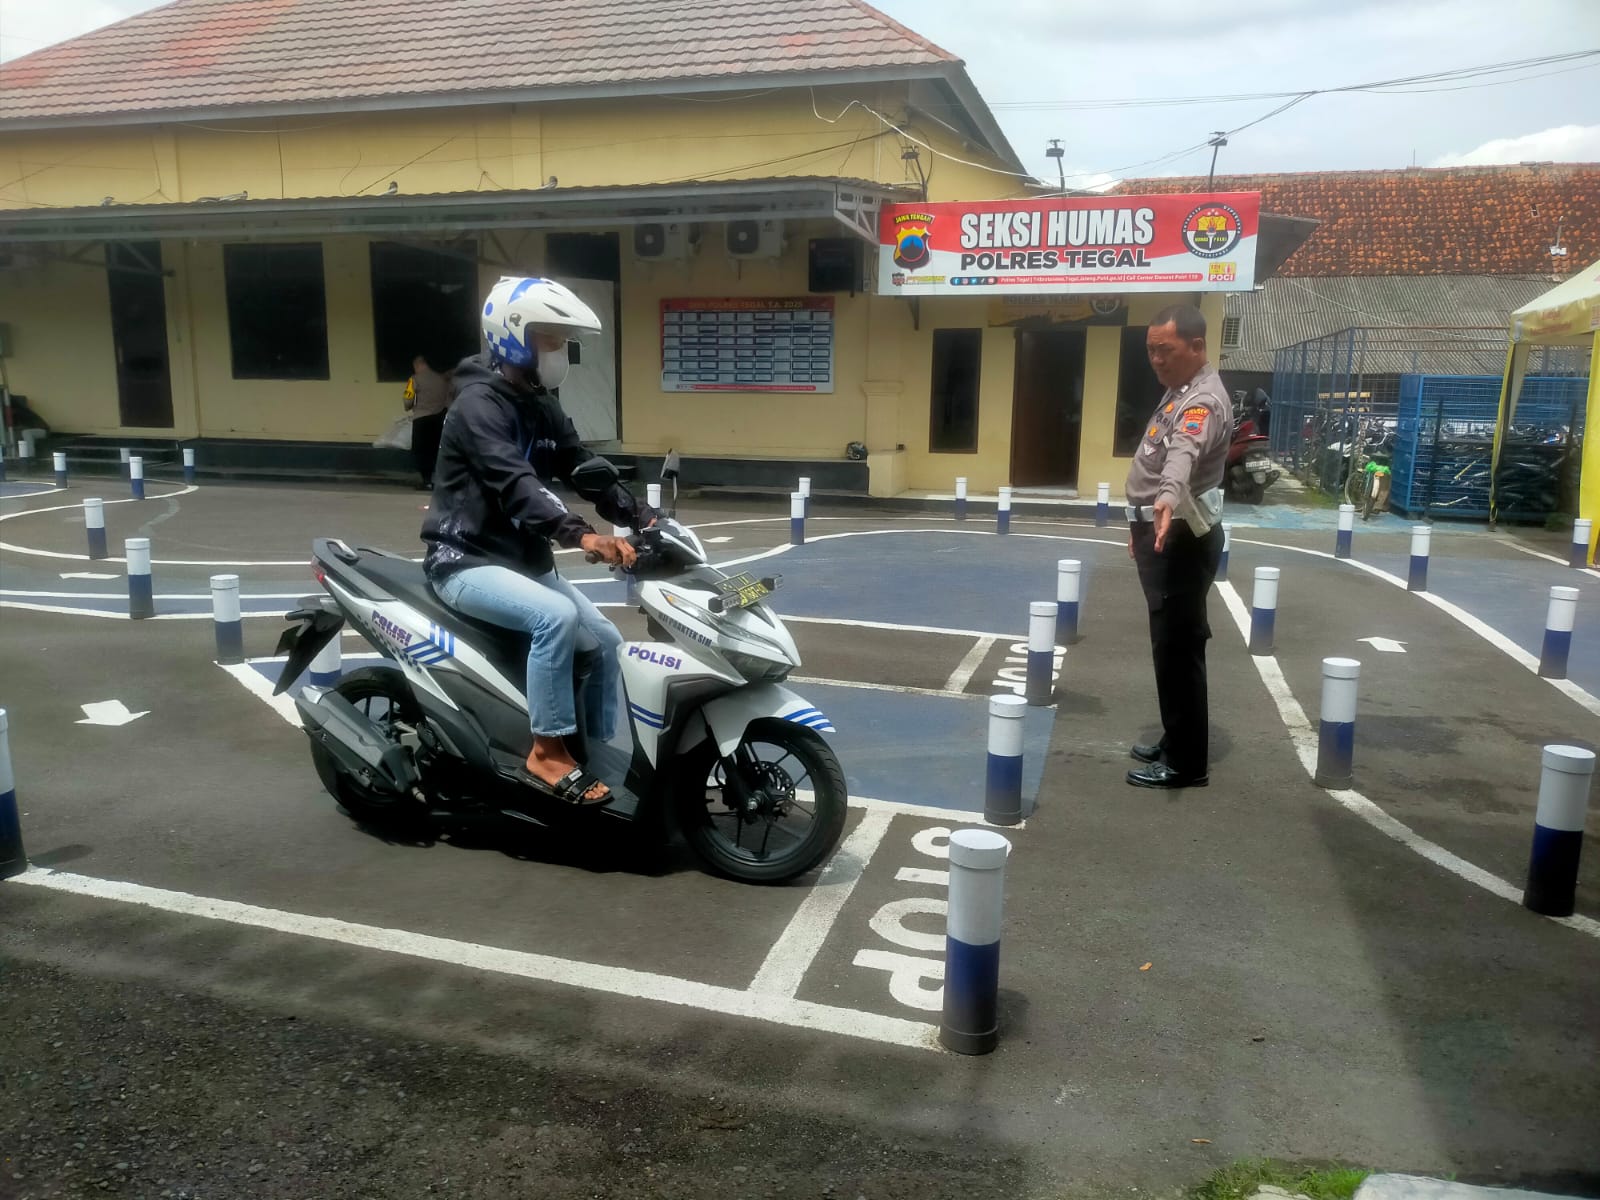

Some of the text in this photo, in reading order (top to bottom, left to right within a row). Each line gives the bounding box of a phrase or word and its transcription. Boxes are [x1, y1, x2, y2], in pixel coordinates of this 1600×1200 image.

[961, 212, 1039, 248] SEKSI
[1048, 208, 1154, 246] HUMAS
[961, 249, 1151, 270] POLRES TEGAL
[698, 633, 713, 648] SIM
[627, 645, 682, 671] POLISI
